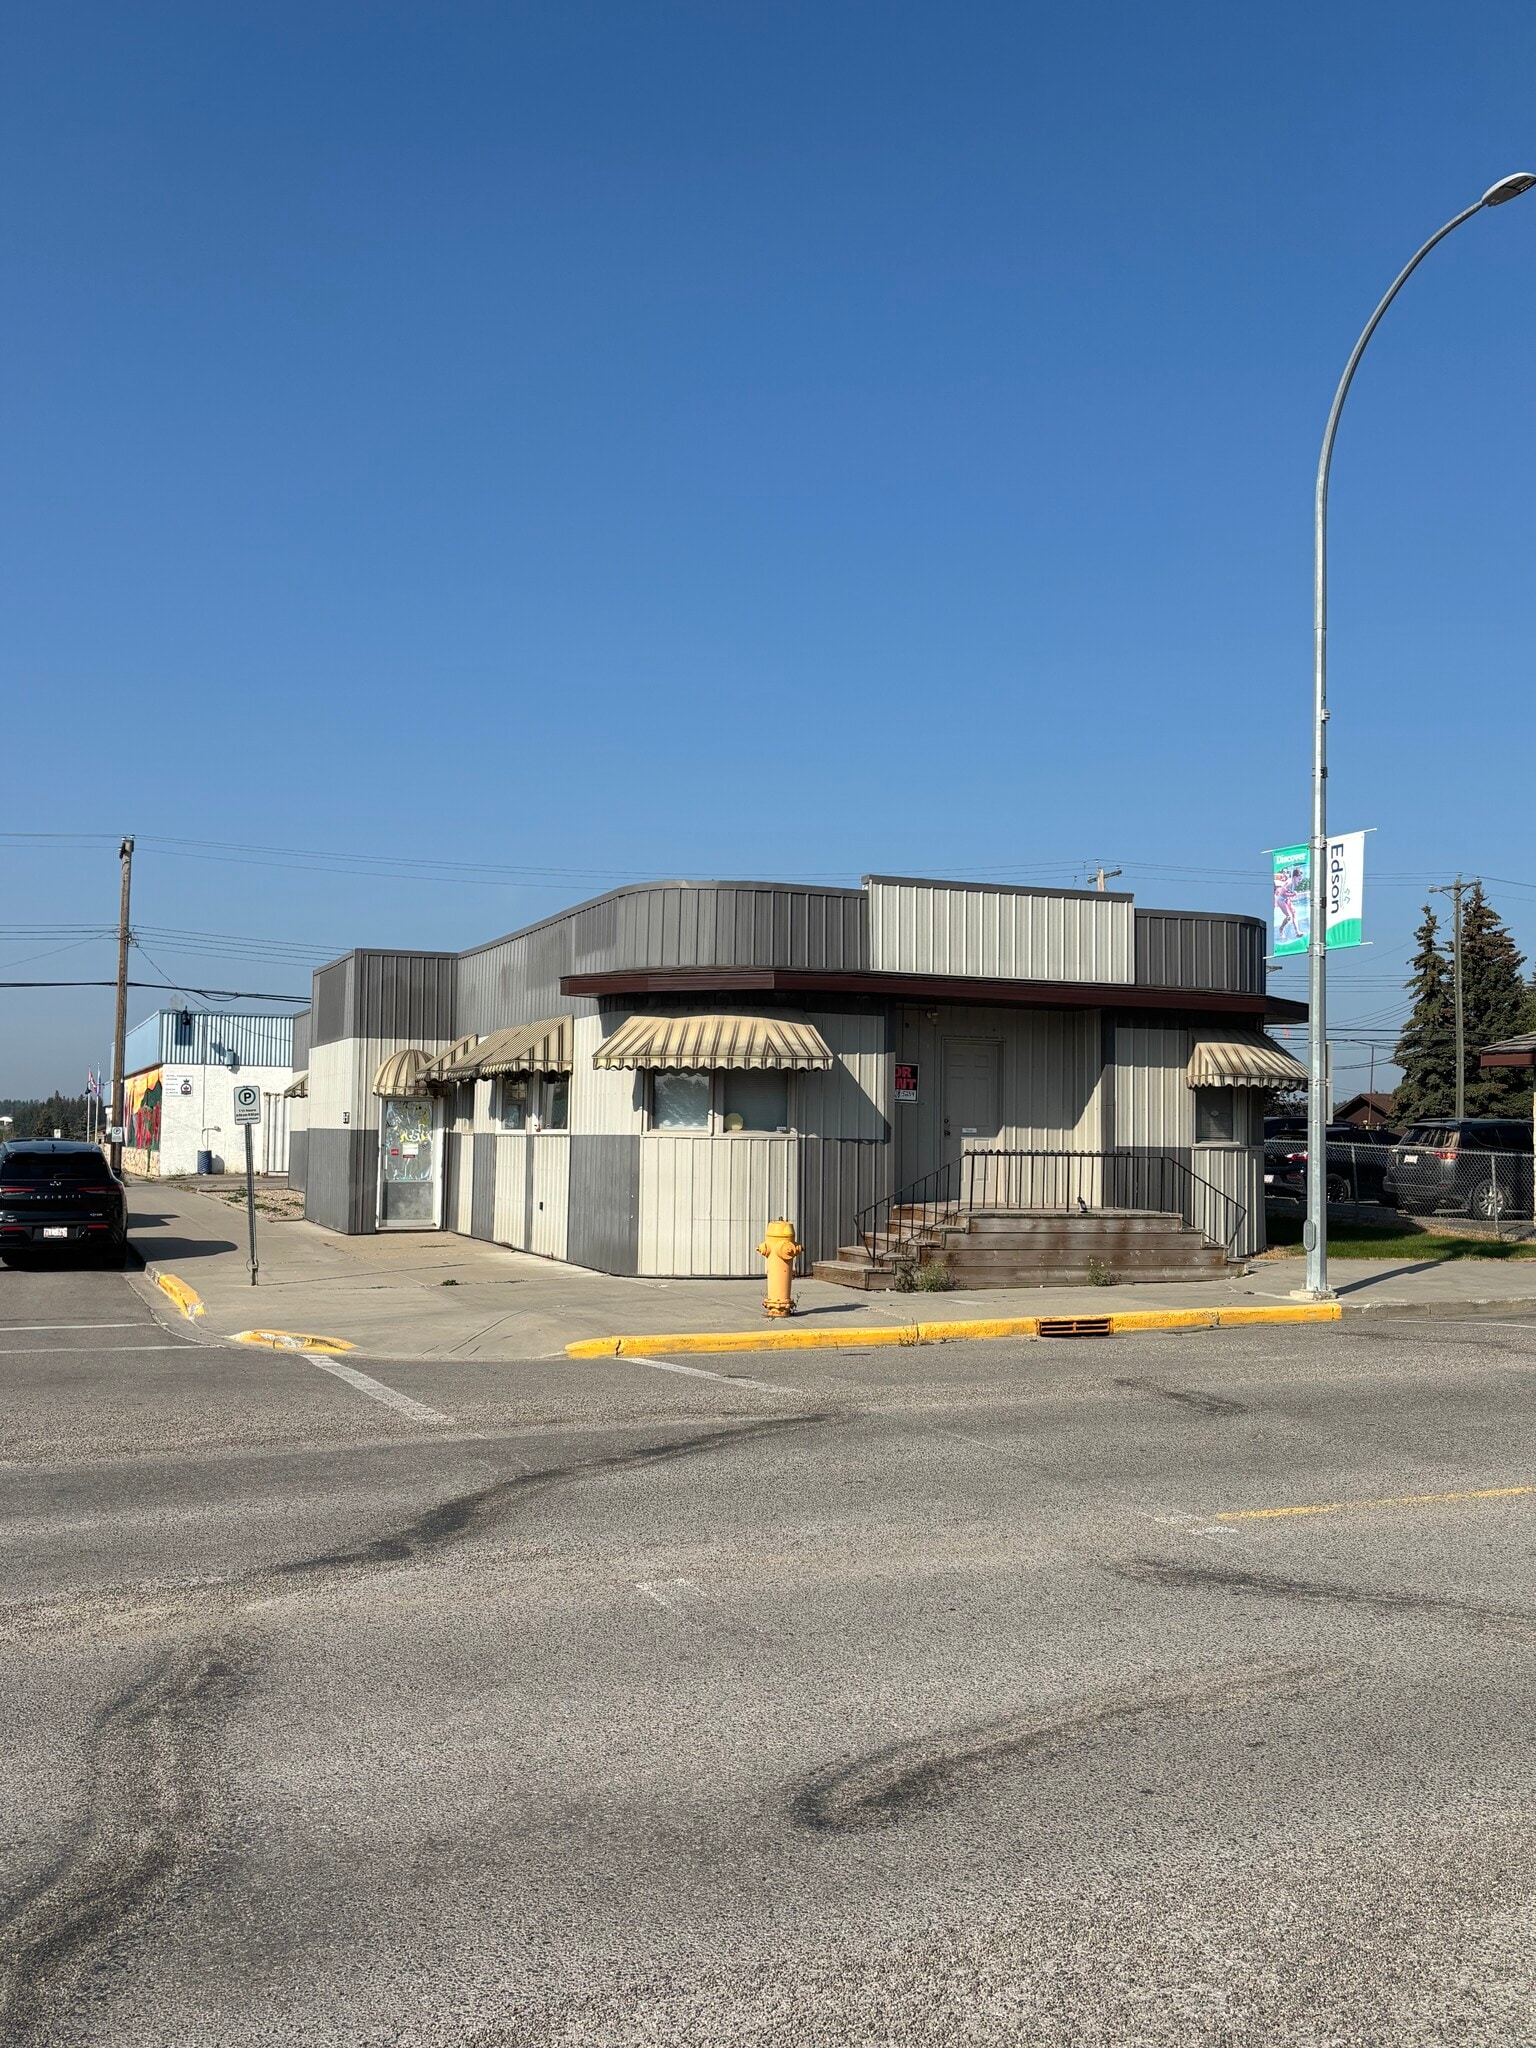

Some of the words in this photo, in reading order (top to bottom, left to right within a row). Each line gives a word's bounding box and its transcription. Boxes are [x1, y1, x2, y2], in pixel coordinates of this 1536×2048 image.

[1276, 852, 1306, 864] Discover
[1330, 843, 1344, 914] Edson
[895, 1066, 912, 1078] OR
[895, 1078, 917, 1090] NT
[243, 1092, 252, 1102] P
